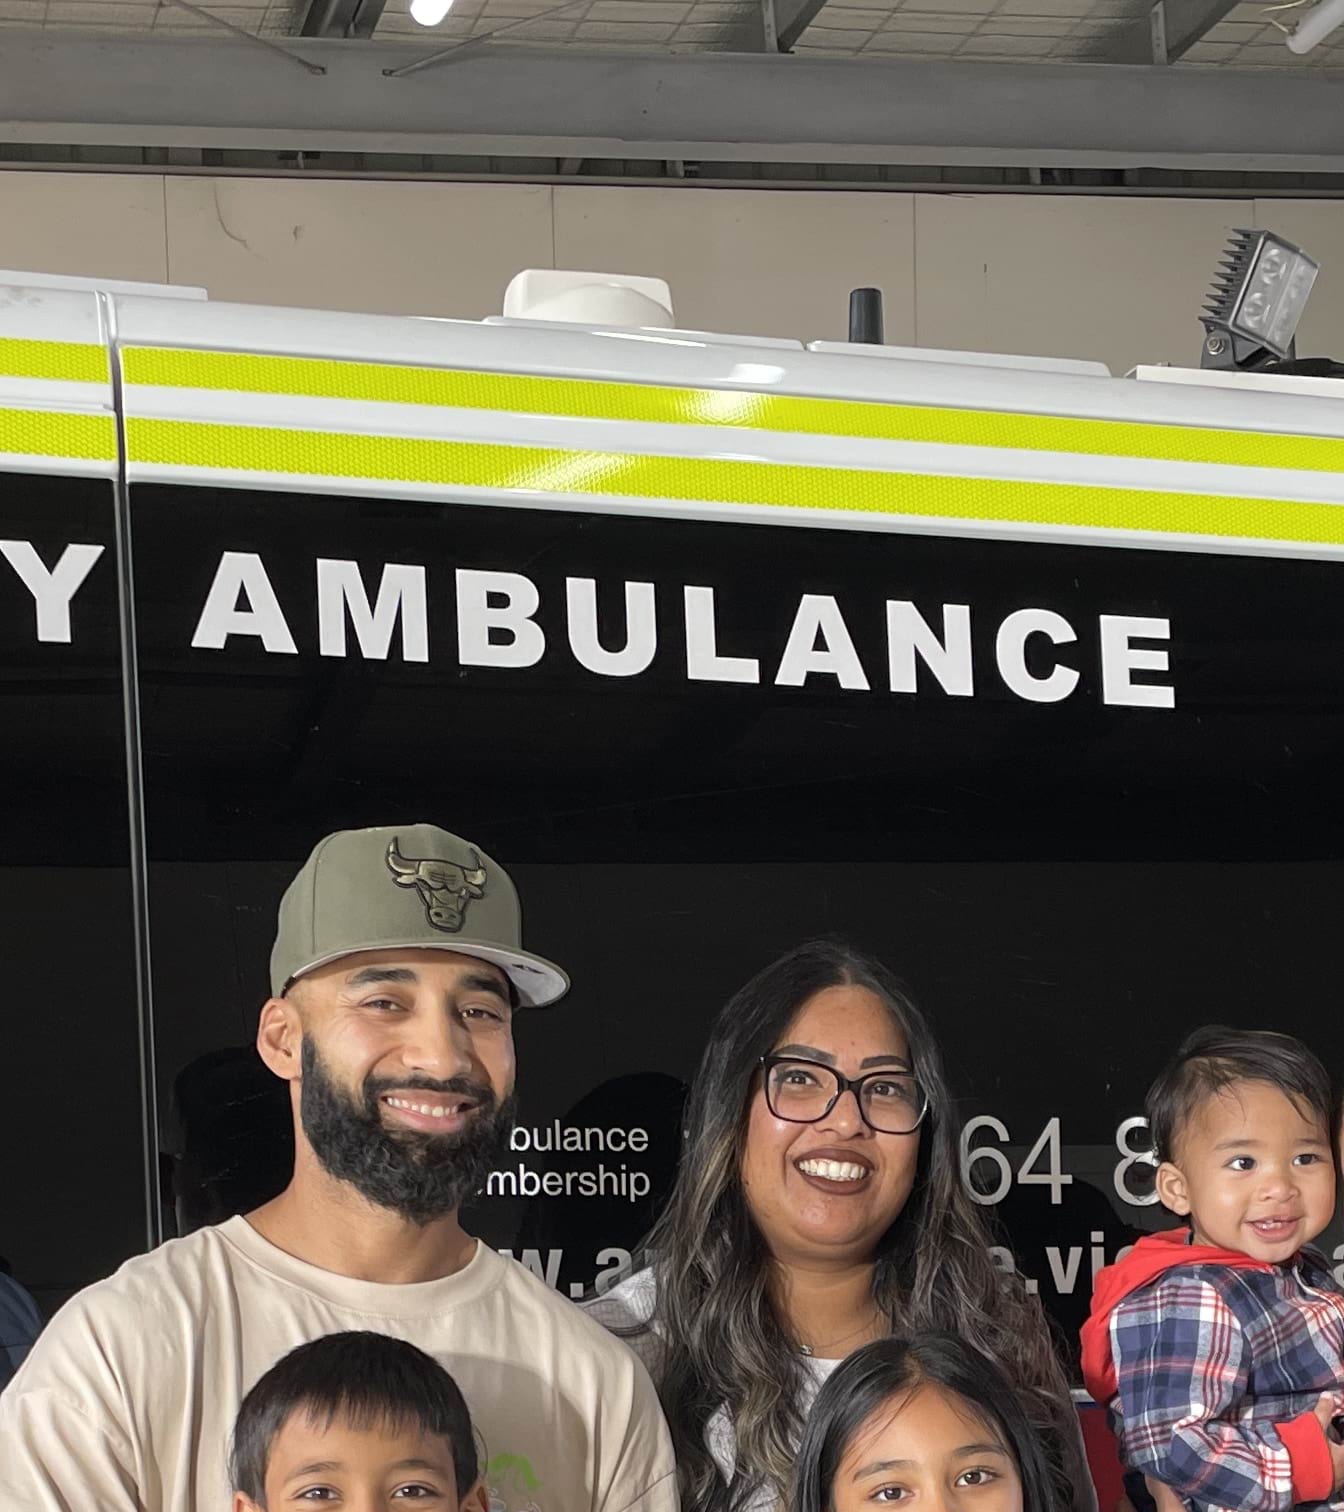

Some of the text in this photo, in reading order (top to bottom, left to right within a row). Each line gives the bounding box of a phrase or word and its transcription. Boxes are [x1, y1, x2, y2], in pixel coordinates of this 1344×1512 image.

[190, 551, 1176, 710] AMBULANCE
[476, 1163, 652, 1203] mbership
[960, 1115, 1073, 1206] 64
